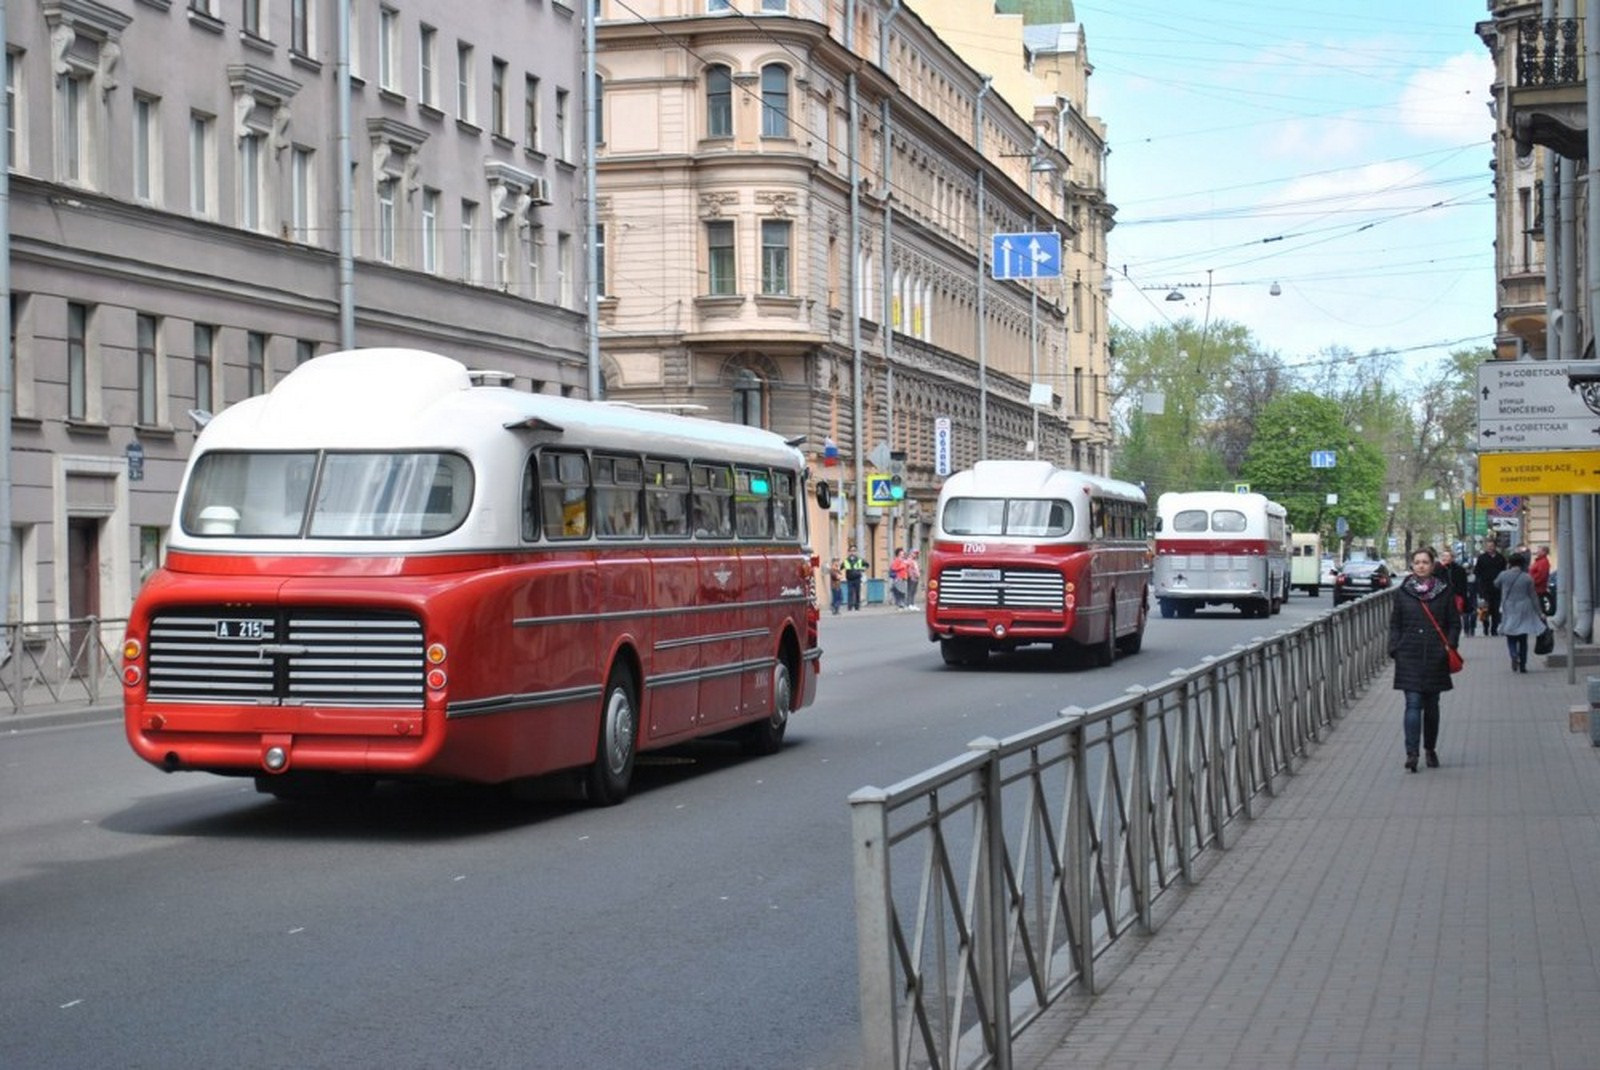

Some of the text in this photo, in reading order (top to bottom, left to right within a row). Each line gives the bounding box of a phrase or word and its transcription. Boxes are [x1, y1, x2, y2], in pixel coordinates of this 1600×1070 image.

[1513, 368, 1568, 377] СОВЕТСКАЯ
[1499, 405, 1555, 414] МОИСЕЕНКО
[1514, 423, 1569, 431] СОВЕТСКАЯ
[239, 621, 260, 637] 215
